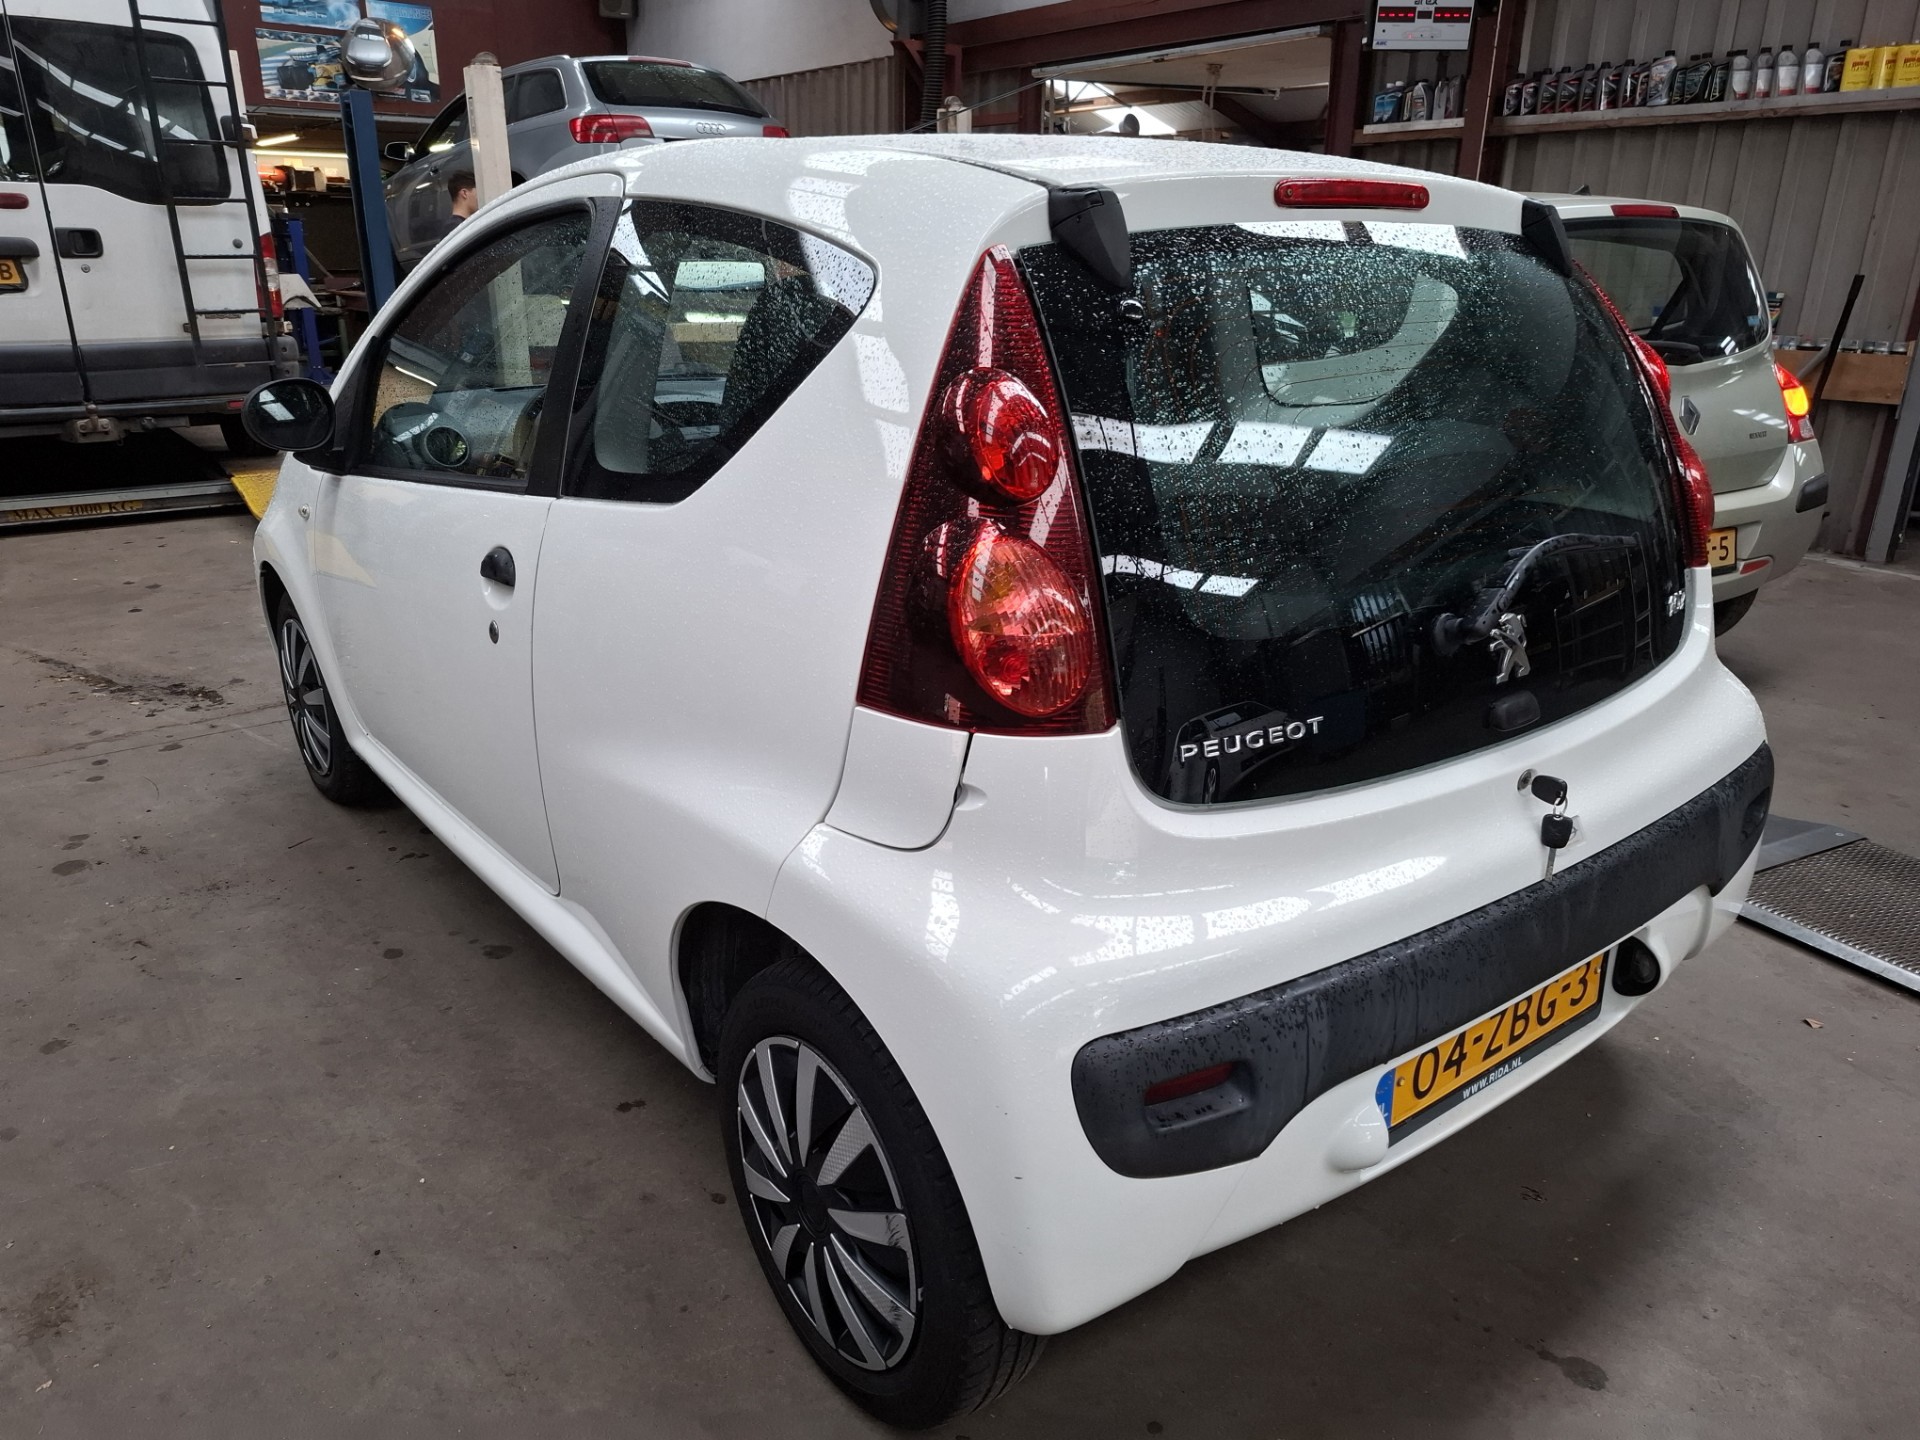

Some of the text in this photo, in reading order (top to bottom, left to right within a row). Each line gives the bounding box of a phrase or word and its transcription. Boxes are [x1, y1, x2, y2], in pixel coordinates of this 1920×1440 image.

[1180, 716, 1324, 762] PEUGEOT
[1413, 961, 1591, 1100] 04-ZBG-3
[1462, 1056, 1523, 1099] WWW.RIDA.NL
